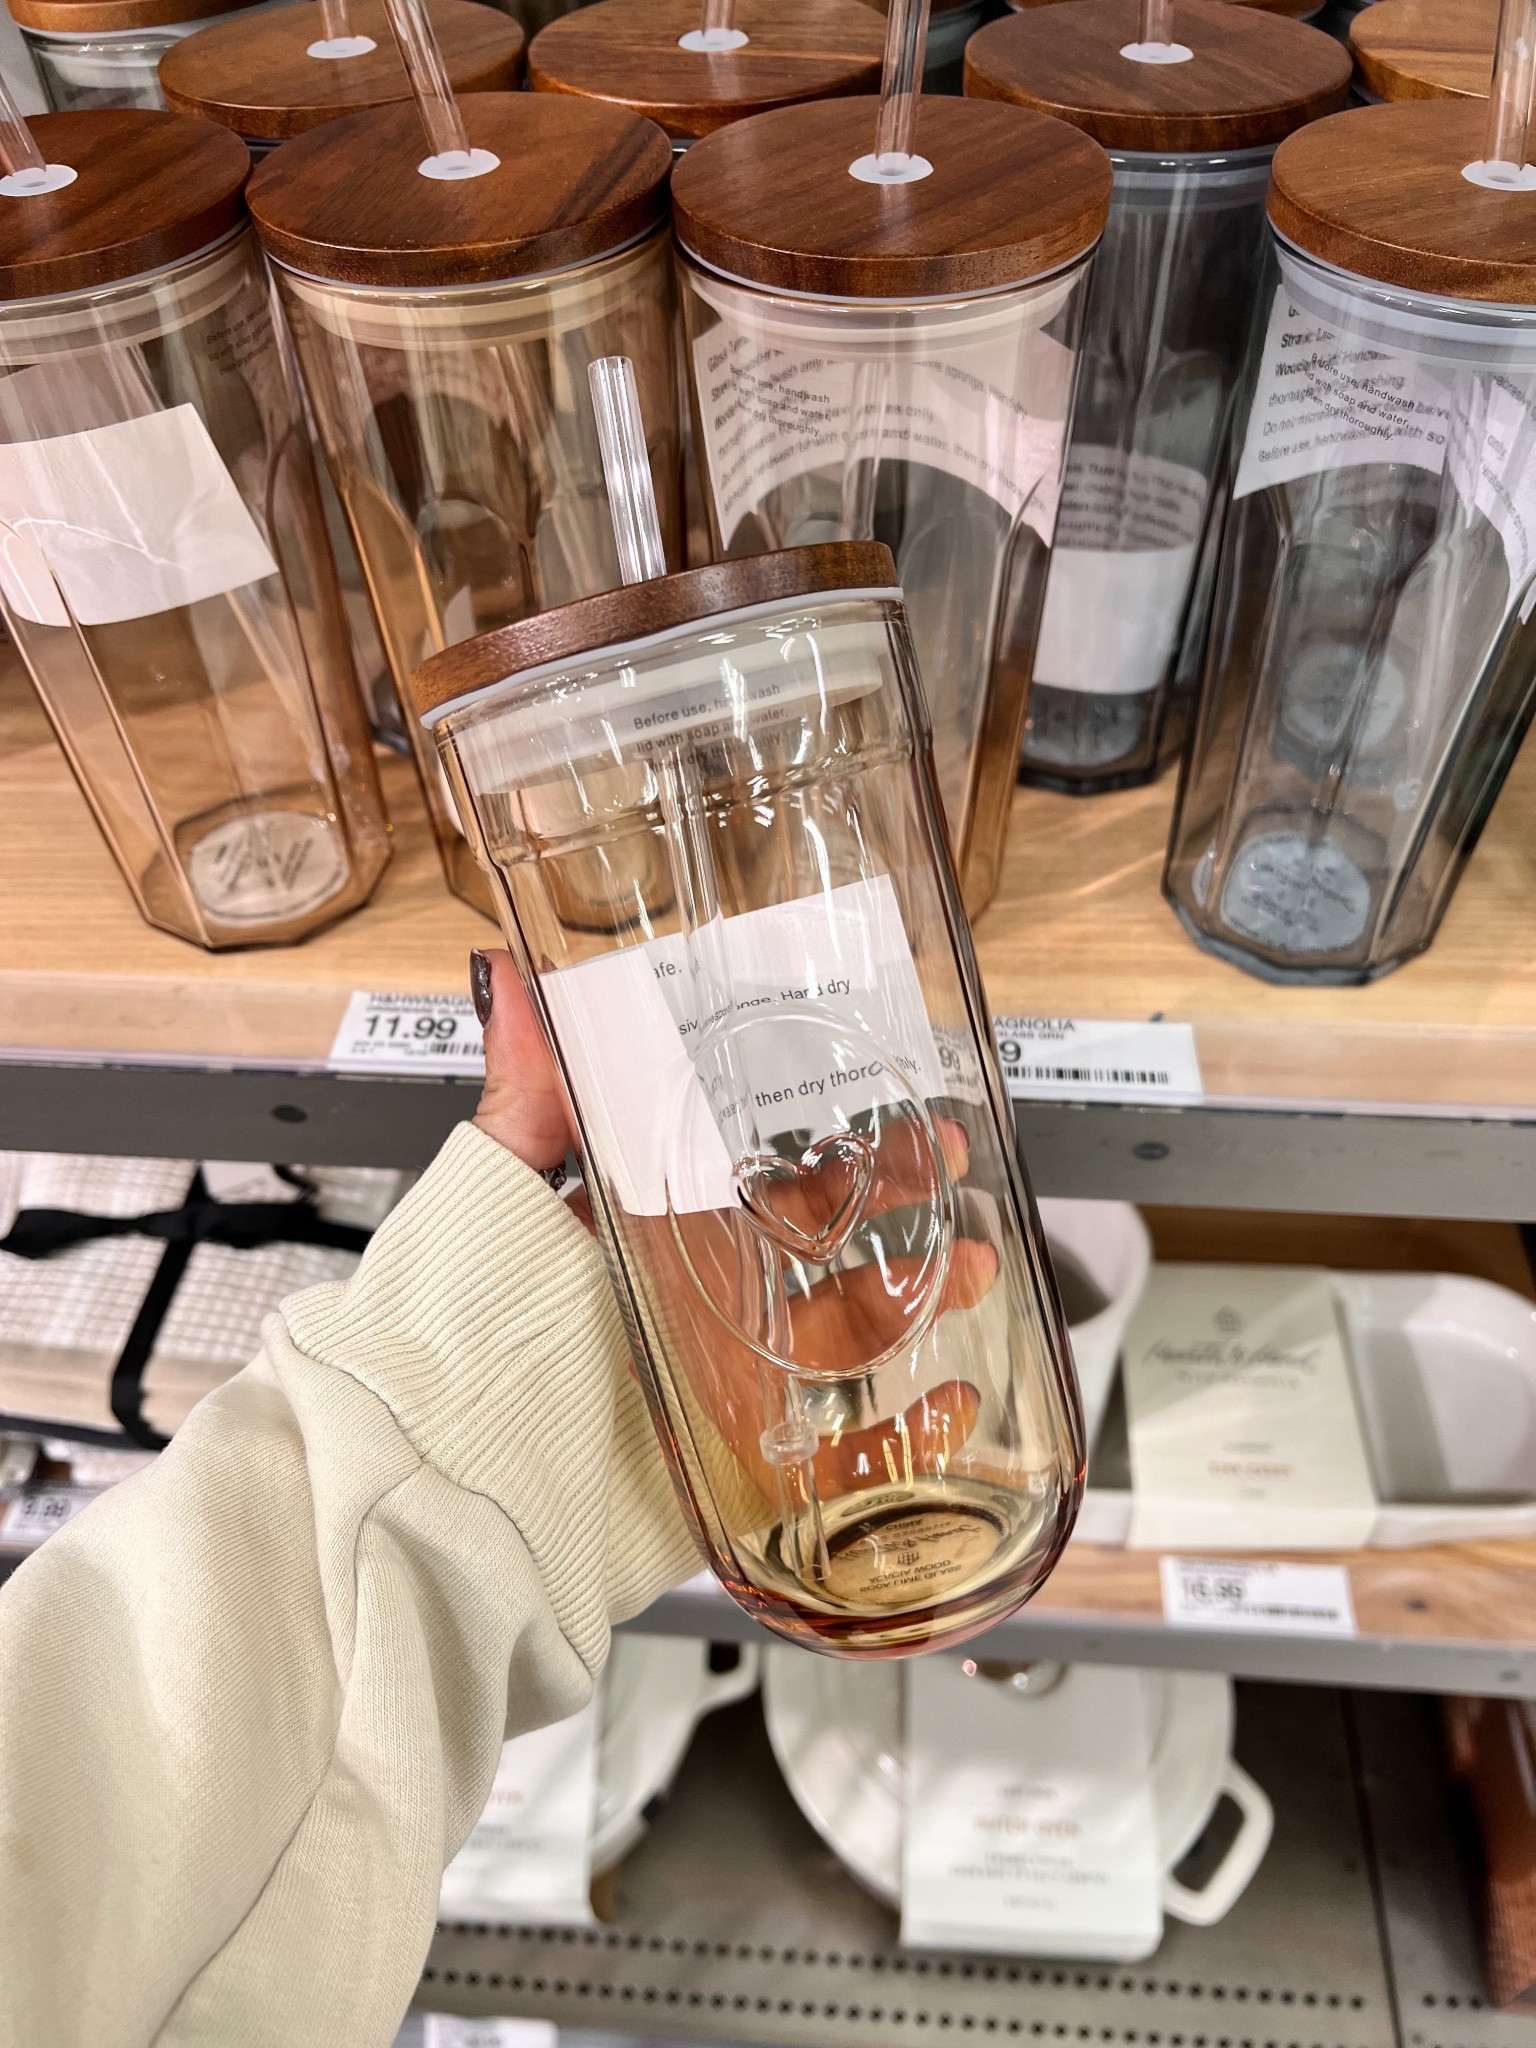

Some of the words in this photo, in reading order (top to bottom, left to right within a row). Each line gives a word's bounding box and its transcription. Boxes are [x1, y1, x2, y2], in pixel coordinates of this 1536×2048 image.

[779, 385, 830, 404] handwash
[1311, 352, 1340, 378] Before
[1339, 372, 1360, 390] use,
[1361, 381, 1416, 410] handwash
[1315, 376, 1333, 393] with
[1332, 388, 1357, 406] soap
[1356, 398, 1378, 415] and
[633, 708, 680, 731] Before
[681, 702, 713, 719] use,
[635, 740, 654, 753] lid
[655, 733, 685, 750] with
[686, 723, 720, 742] soap
[826, 977, 851, 995] dry
[364, 1013, 459, 1040] 11.99
[754, 1086, 795, 1108] then
[798, 1077, 826, 1097] dry
